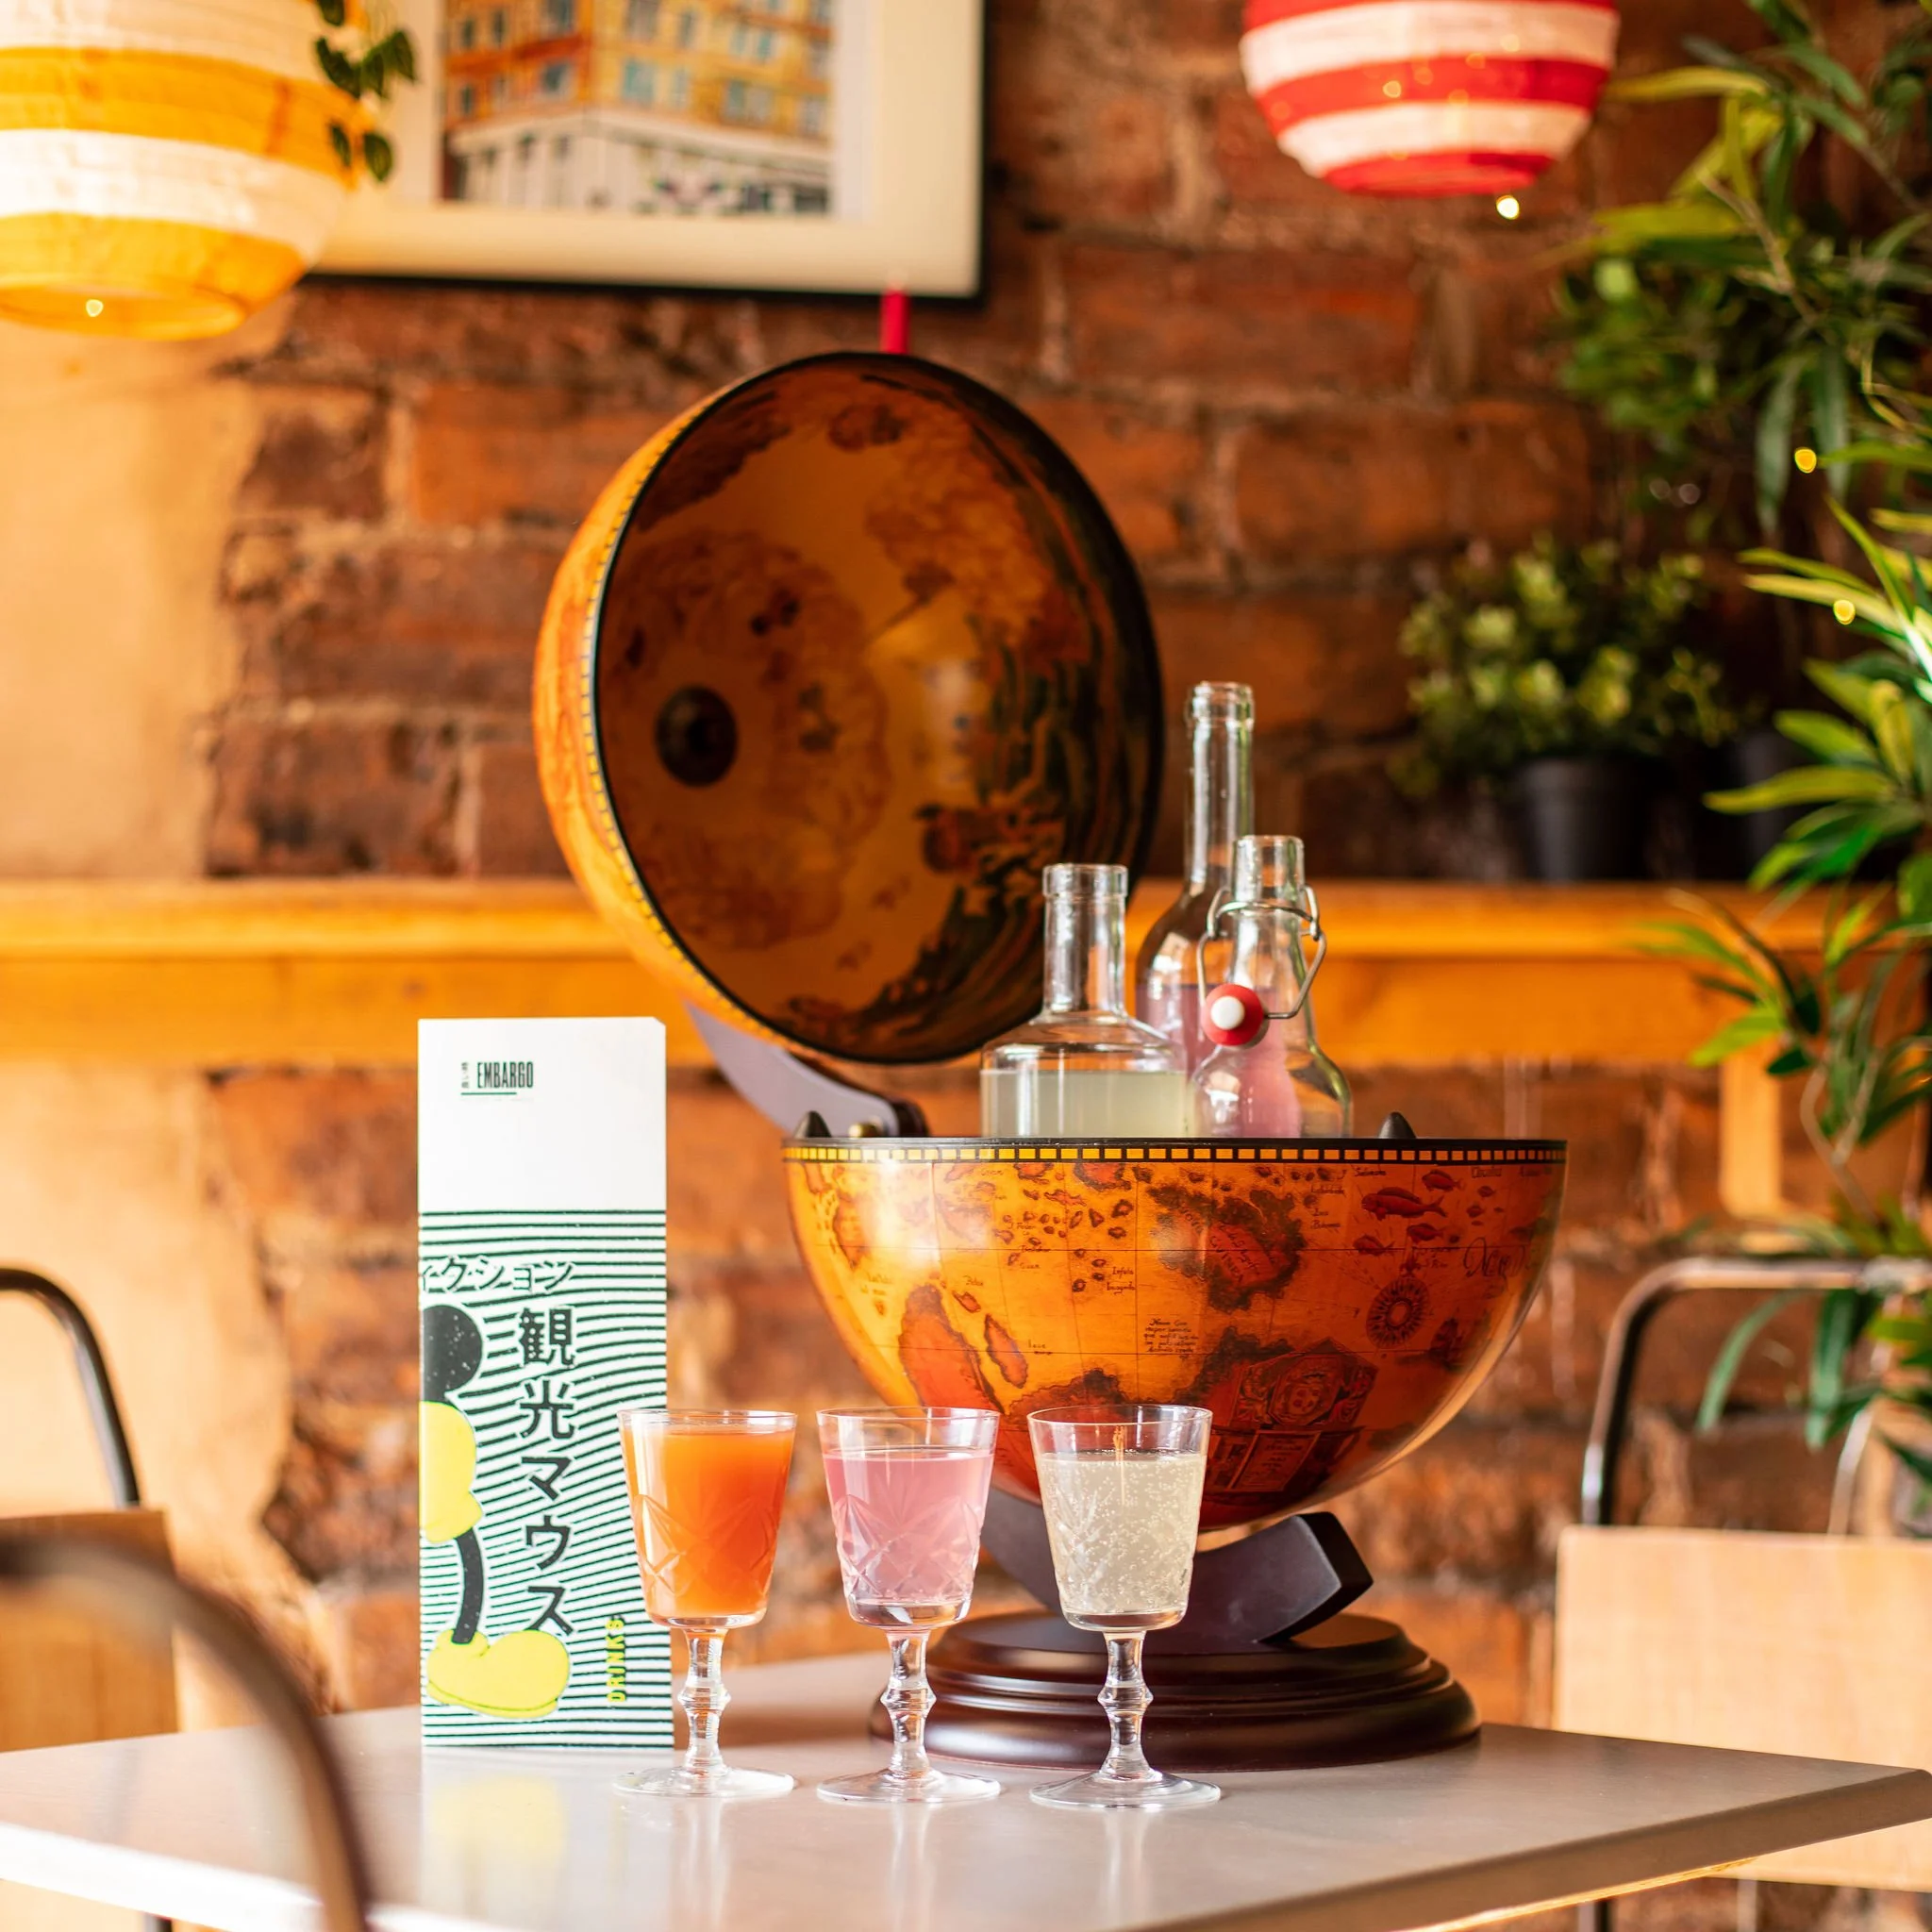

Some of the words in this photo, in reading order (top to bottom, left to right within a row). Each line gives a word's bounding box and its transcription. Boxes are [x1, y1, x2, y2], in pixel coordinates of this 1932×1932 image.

[477, 1061, 534, 1089] EMBARGO
[519, 1307, 576, 1637] 観光マウス
[605, 1615, 627, 1704] DRINKS
